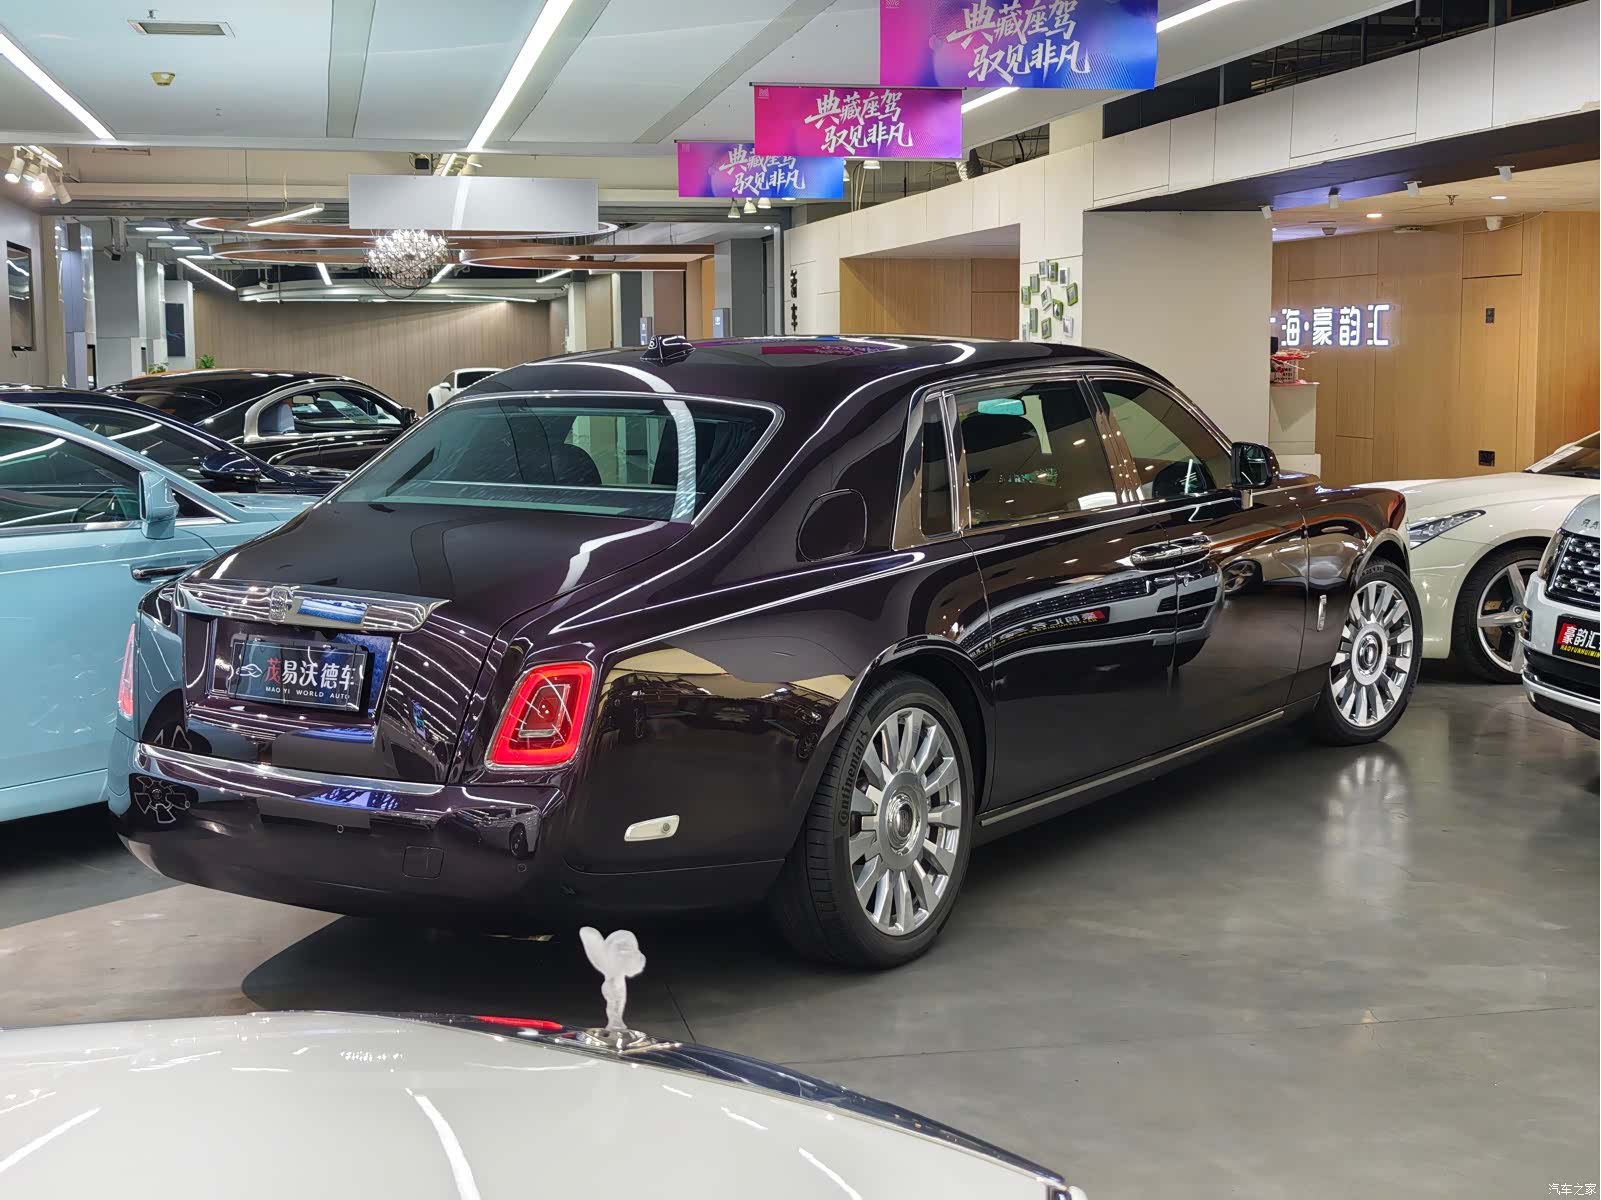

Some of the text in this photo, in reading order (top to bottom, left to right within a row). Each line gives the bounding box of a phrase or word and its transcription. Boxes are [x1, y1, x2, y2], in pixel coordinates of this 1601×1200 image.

[946, 0, 1079, 47] 典藏座驾
[968, 37, 1091, 84] 驭见非凡
[804, 89, 904, 130] 典藏座驾
[820, 121, 914, 155] 驭见非凡
[732, 168, 807, 196] 驭见非凡
[1269, 304, 1391, 347] 海·豪韵汇
[1561, 625, 1600, 650] 豪韵汇
[265, 657, 356, 691] 茂易沃德车
[265, 686, 281, 694] MAO
[296, 689, 325, 698] WORLD
